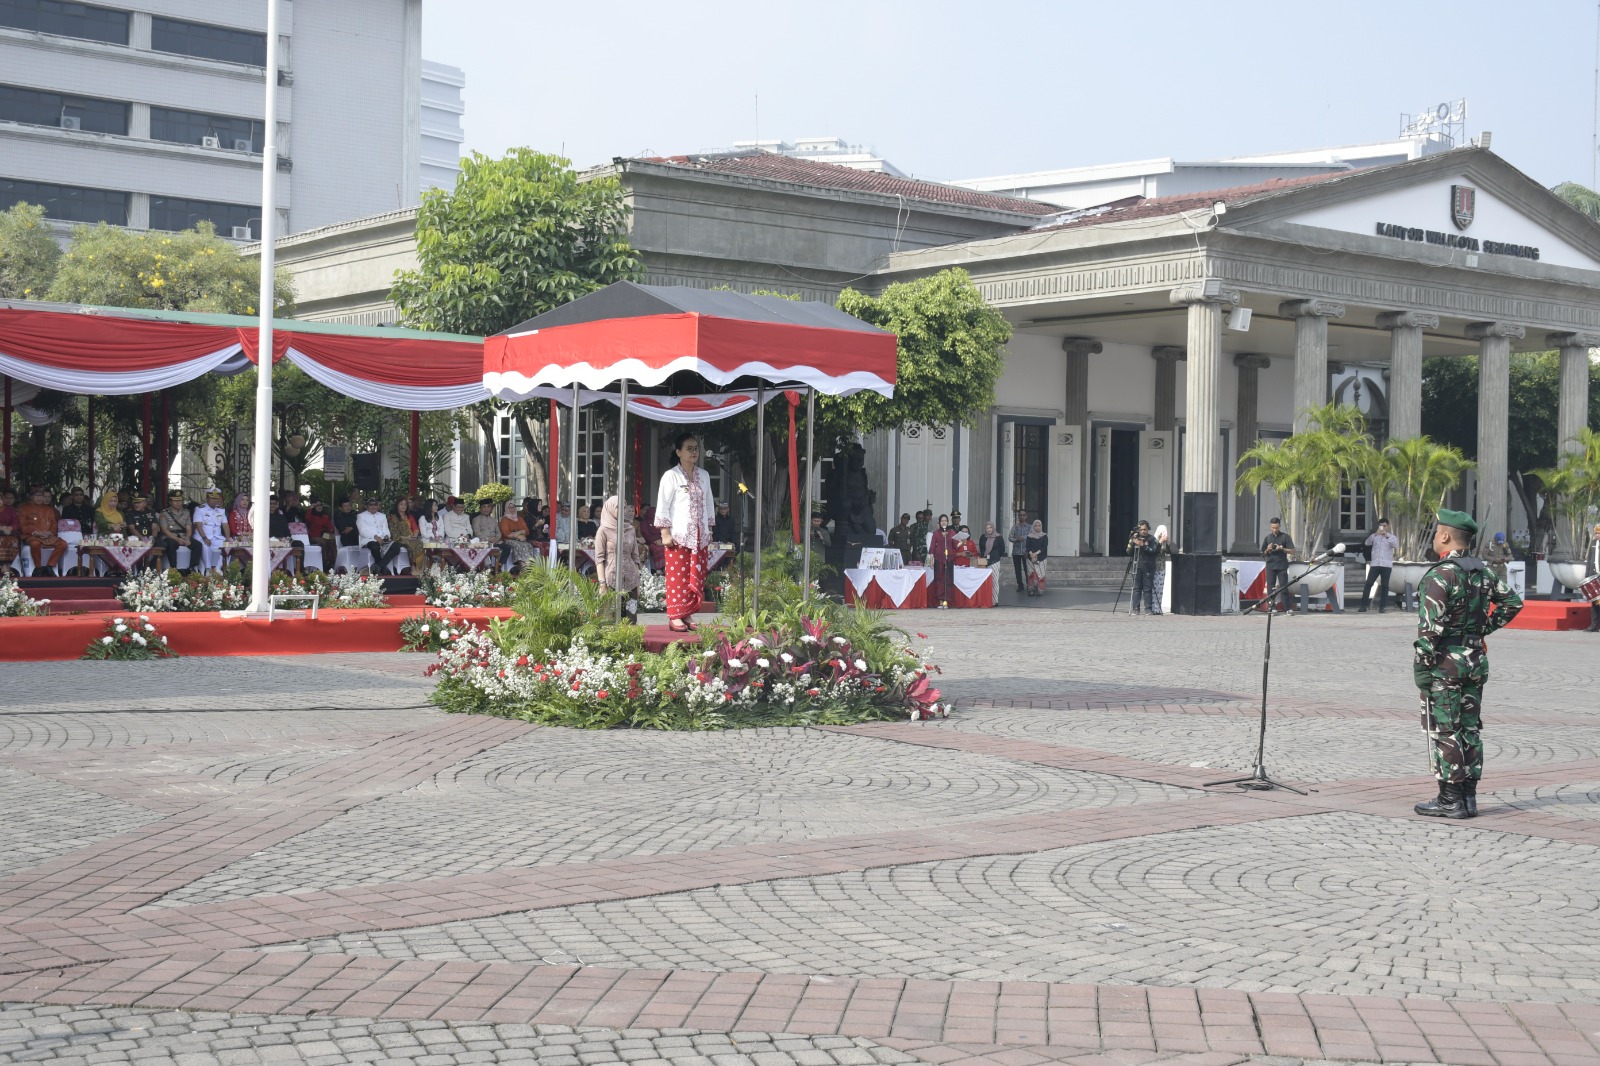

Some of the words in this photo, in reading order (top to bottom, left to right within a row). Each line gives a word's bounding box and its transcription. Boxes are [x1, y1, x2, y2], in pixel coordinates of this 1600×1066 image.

[1376, 222, 1424, 241] KANTOR
[1426, 230, 1479, 251] WALIKOTA
[1483, 240, 1540, 260] SEMARANG
